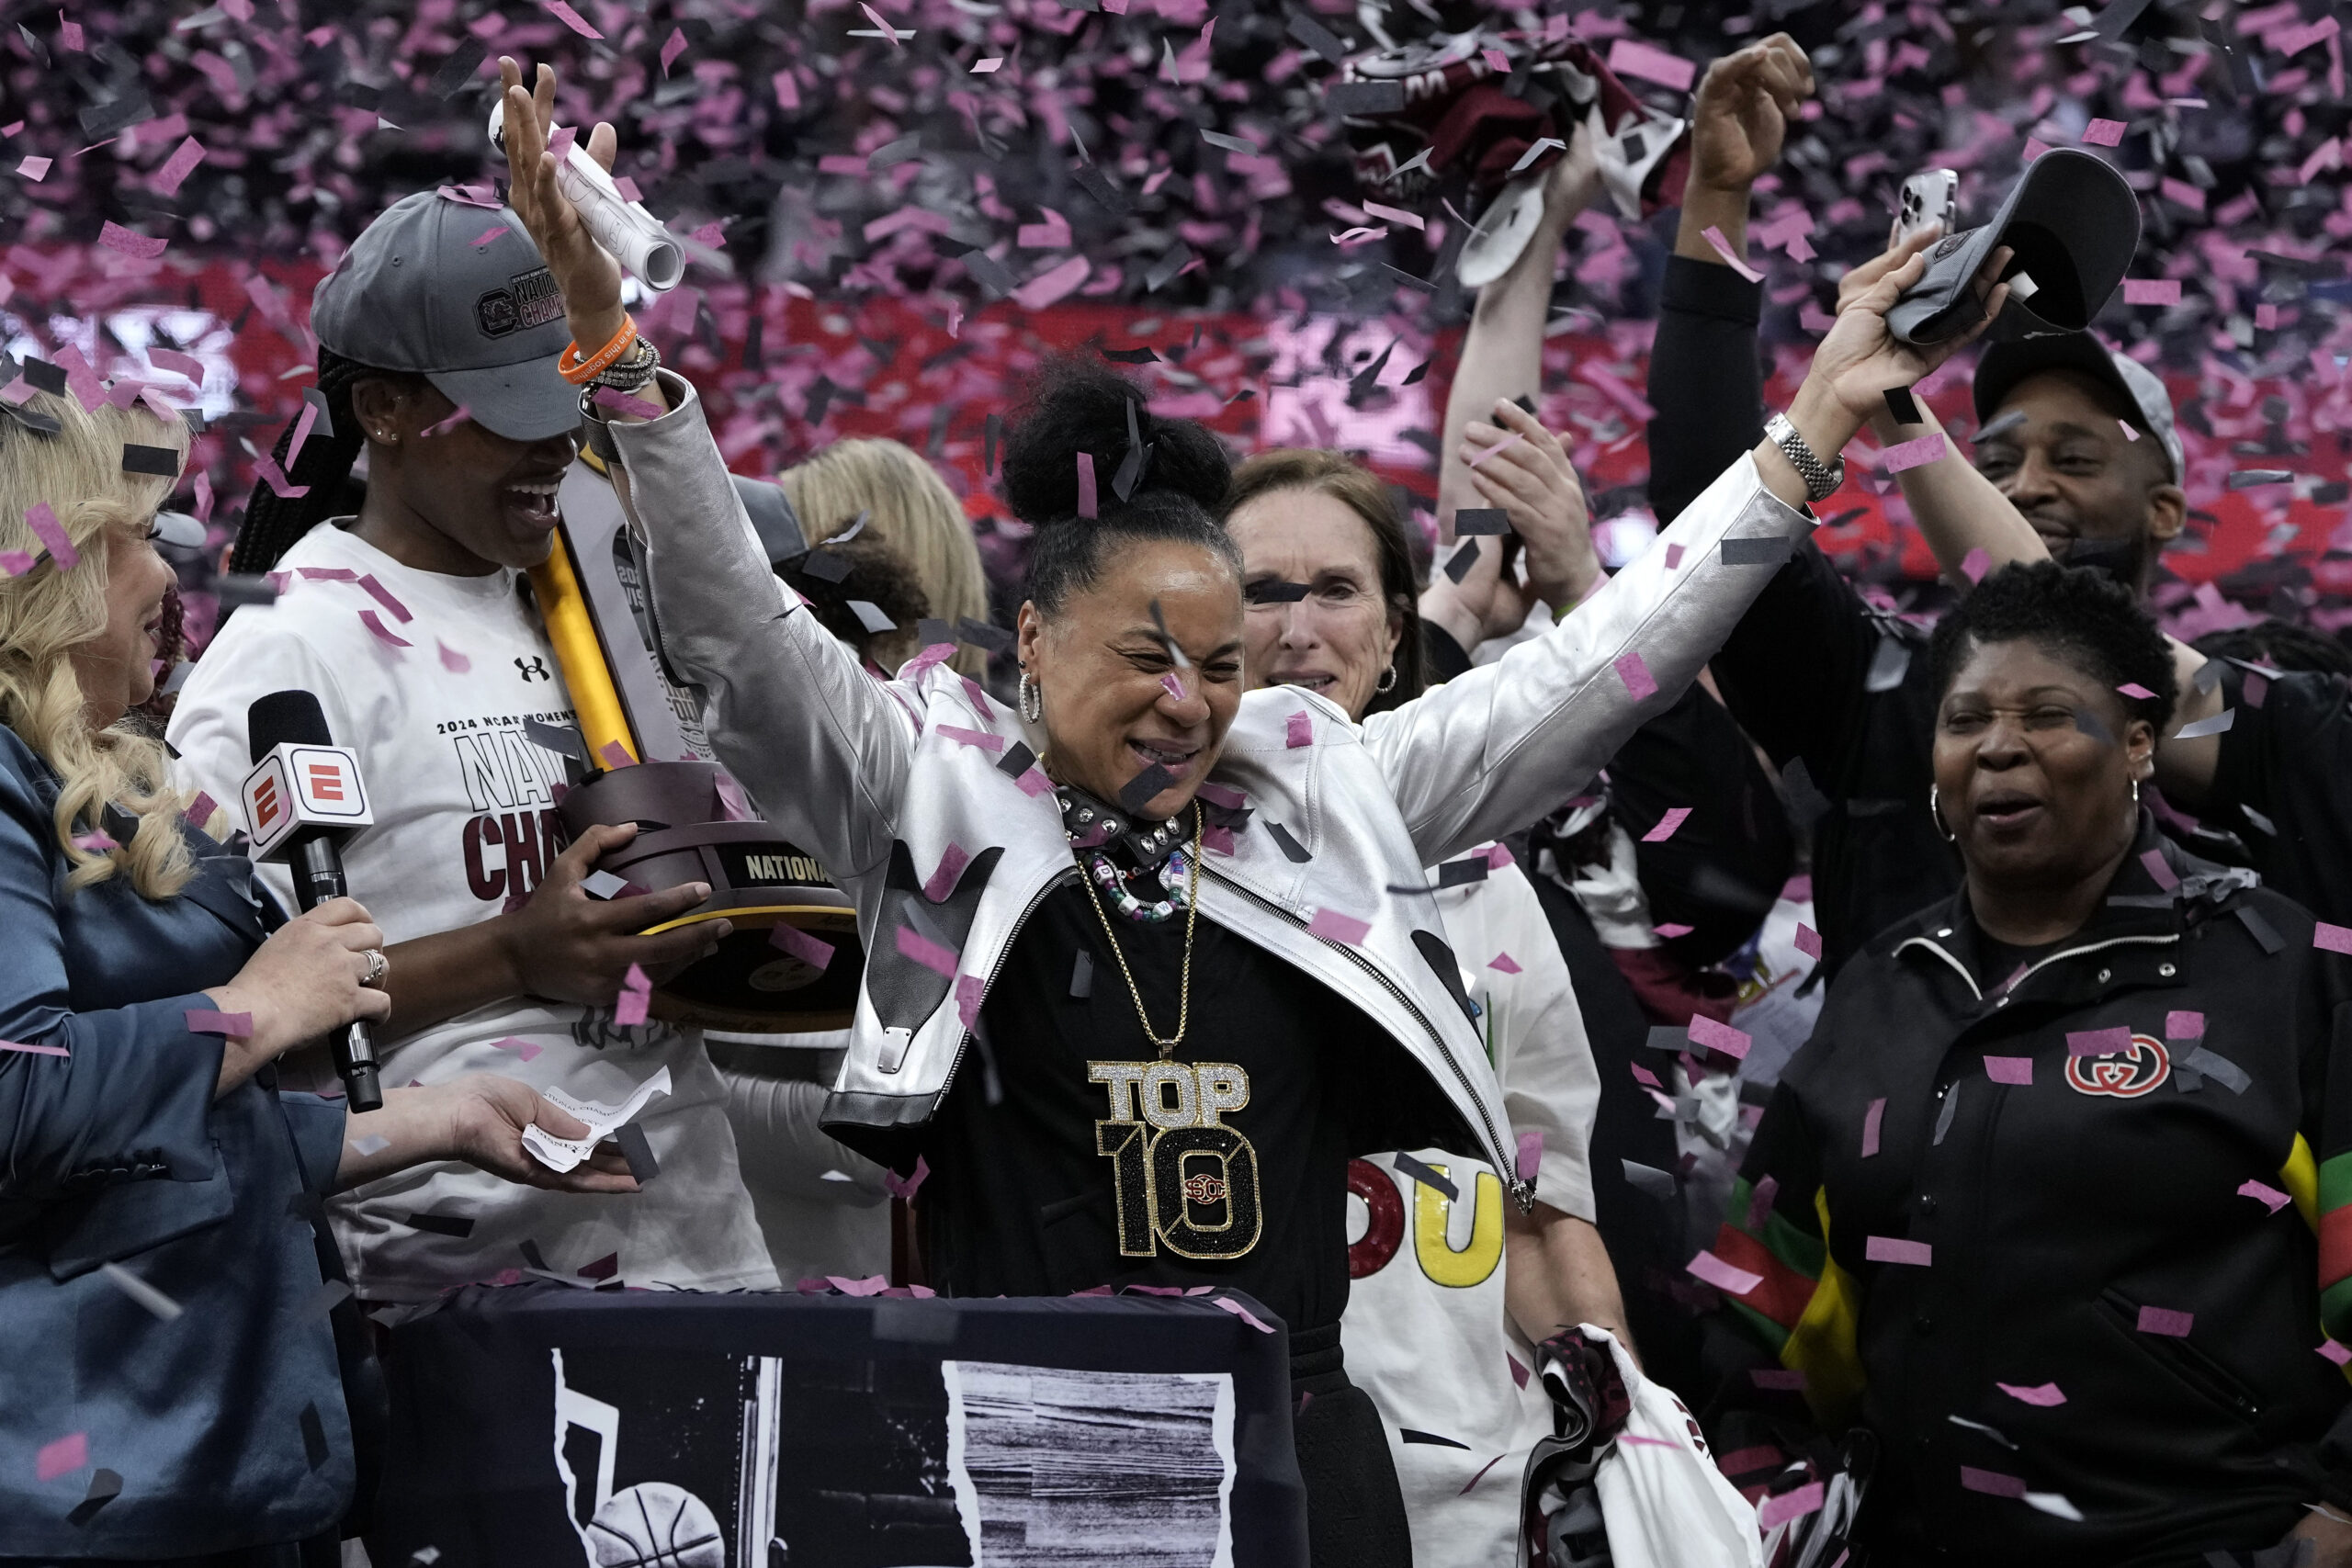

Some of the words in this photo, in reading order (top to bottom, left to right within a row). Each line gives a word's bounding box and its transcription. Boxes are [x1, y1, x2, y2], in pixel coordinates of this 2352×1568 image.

[514, 274, 560, 306] NATIO
[520, 294, 565, 327] CHAMP
[605, 343, 621, 359] this
[618, 333, 628, 344] in
[436, 718, 478, 735] 2024
[745, 854, 831, 883] NATIONA
[544, 1092, 576, 1111] TIONAL
[1087, 1060, 1250, 1129] TOP
[1095, 1119, 1263, 1260] 10
